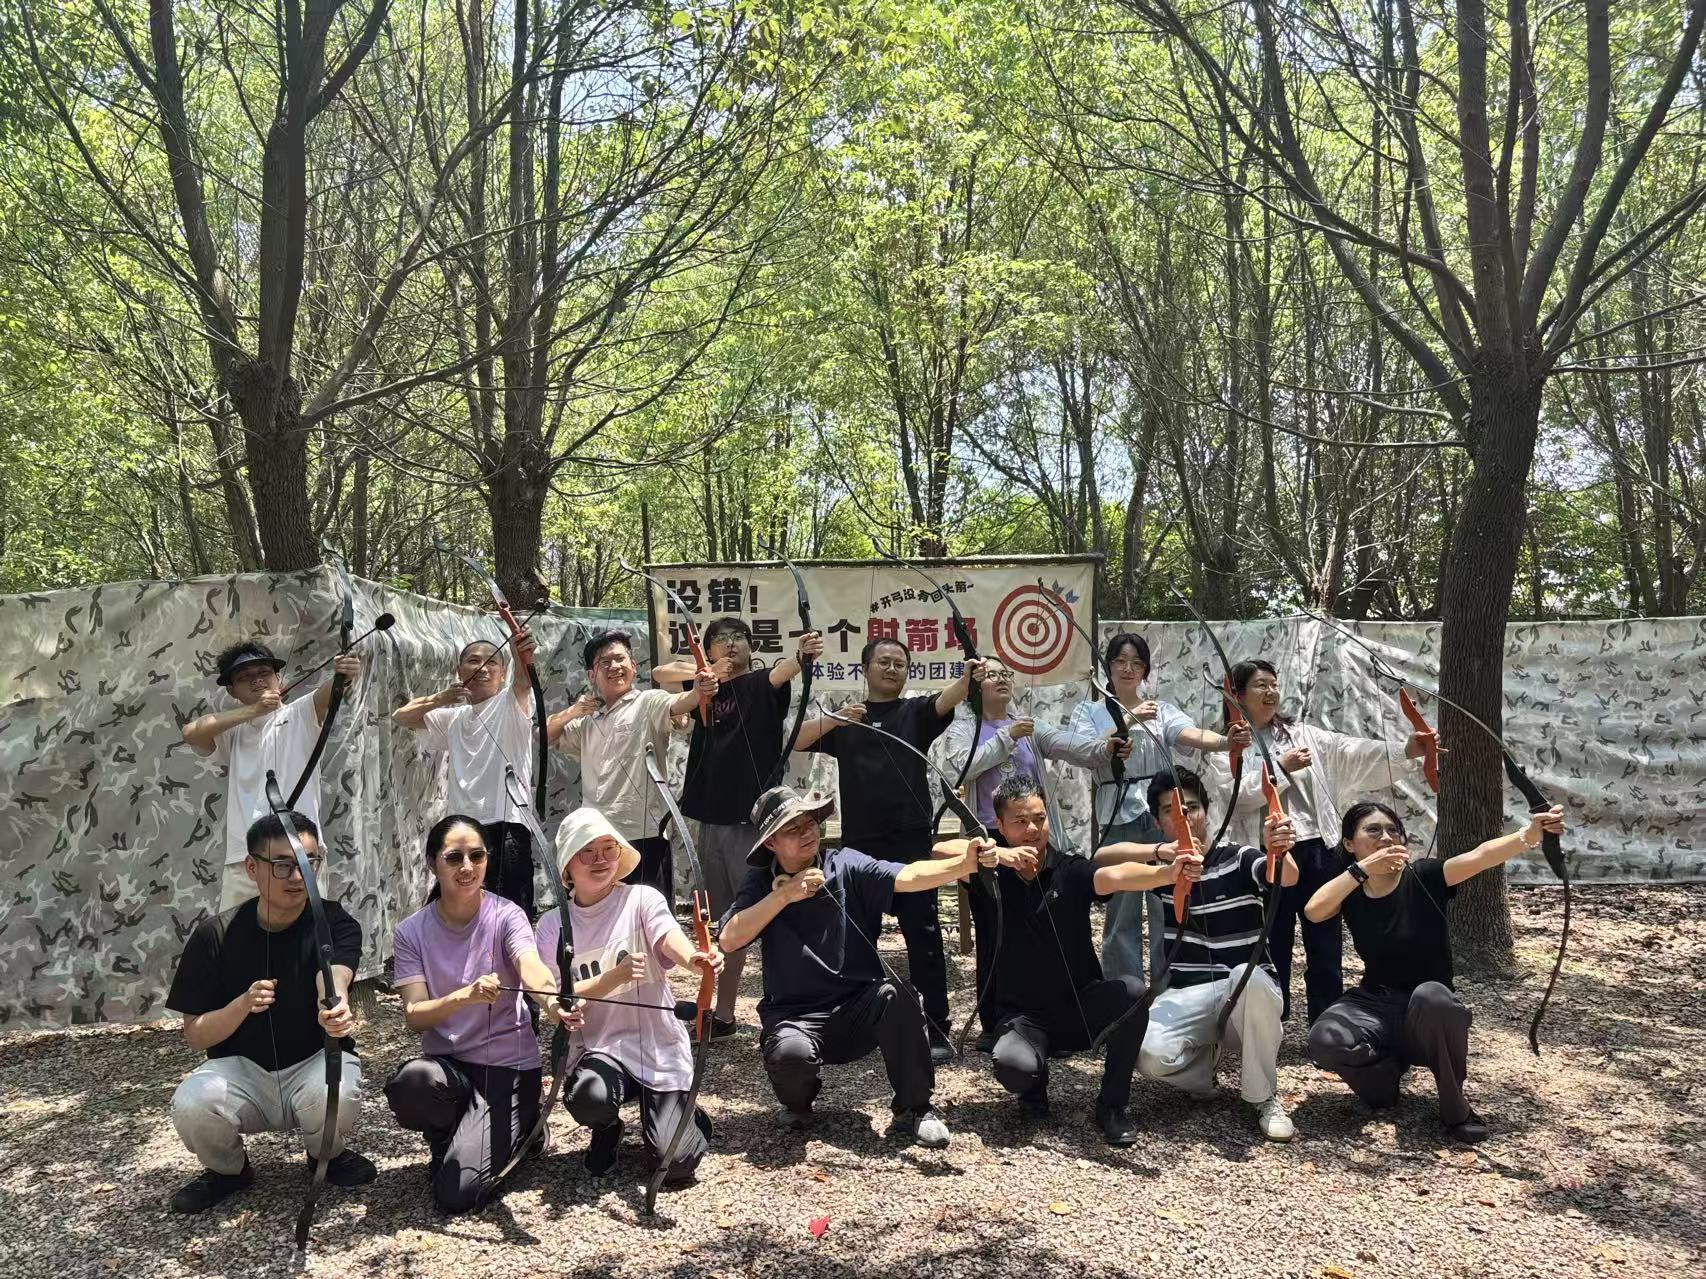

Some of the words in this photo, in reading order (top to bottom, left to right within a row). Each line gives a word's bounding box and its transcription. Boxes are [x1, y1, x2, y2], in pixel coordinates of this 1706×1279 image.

[668, 617, 978, 655] 这是一个射箭场
[811, 662, 965, 681] 体验不的团建
